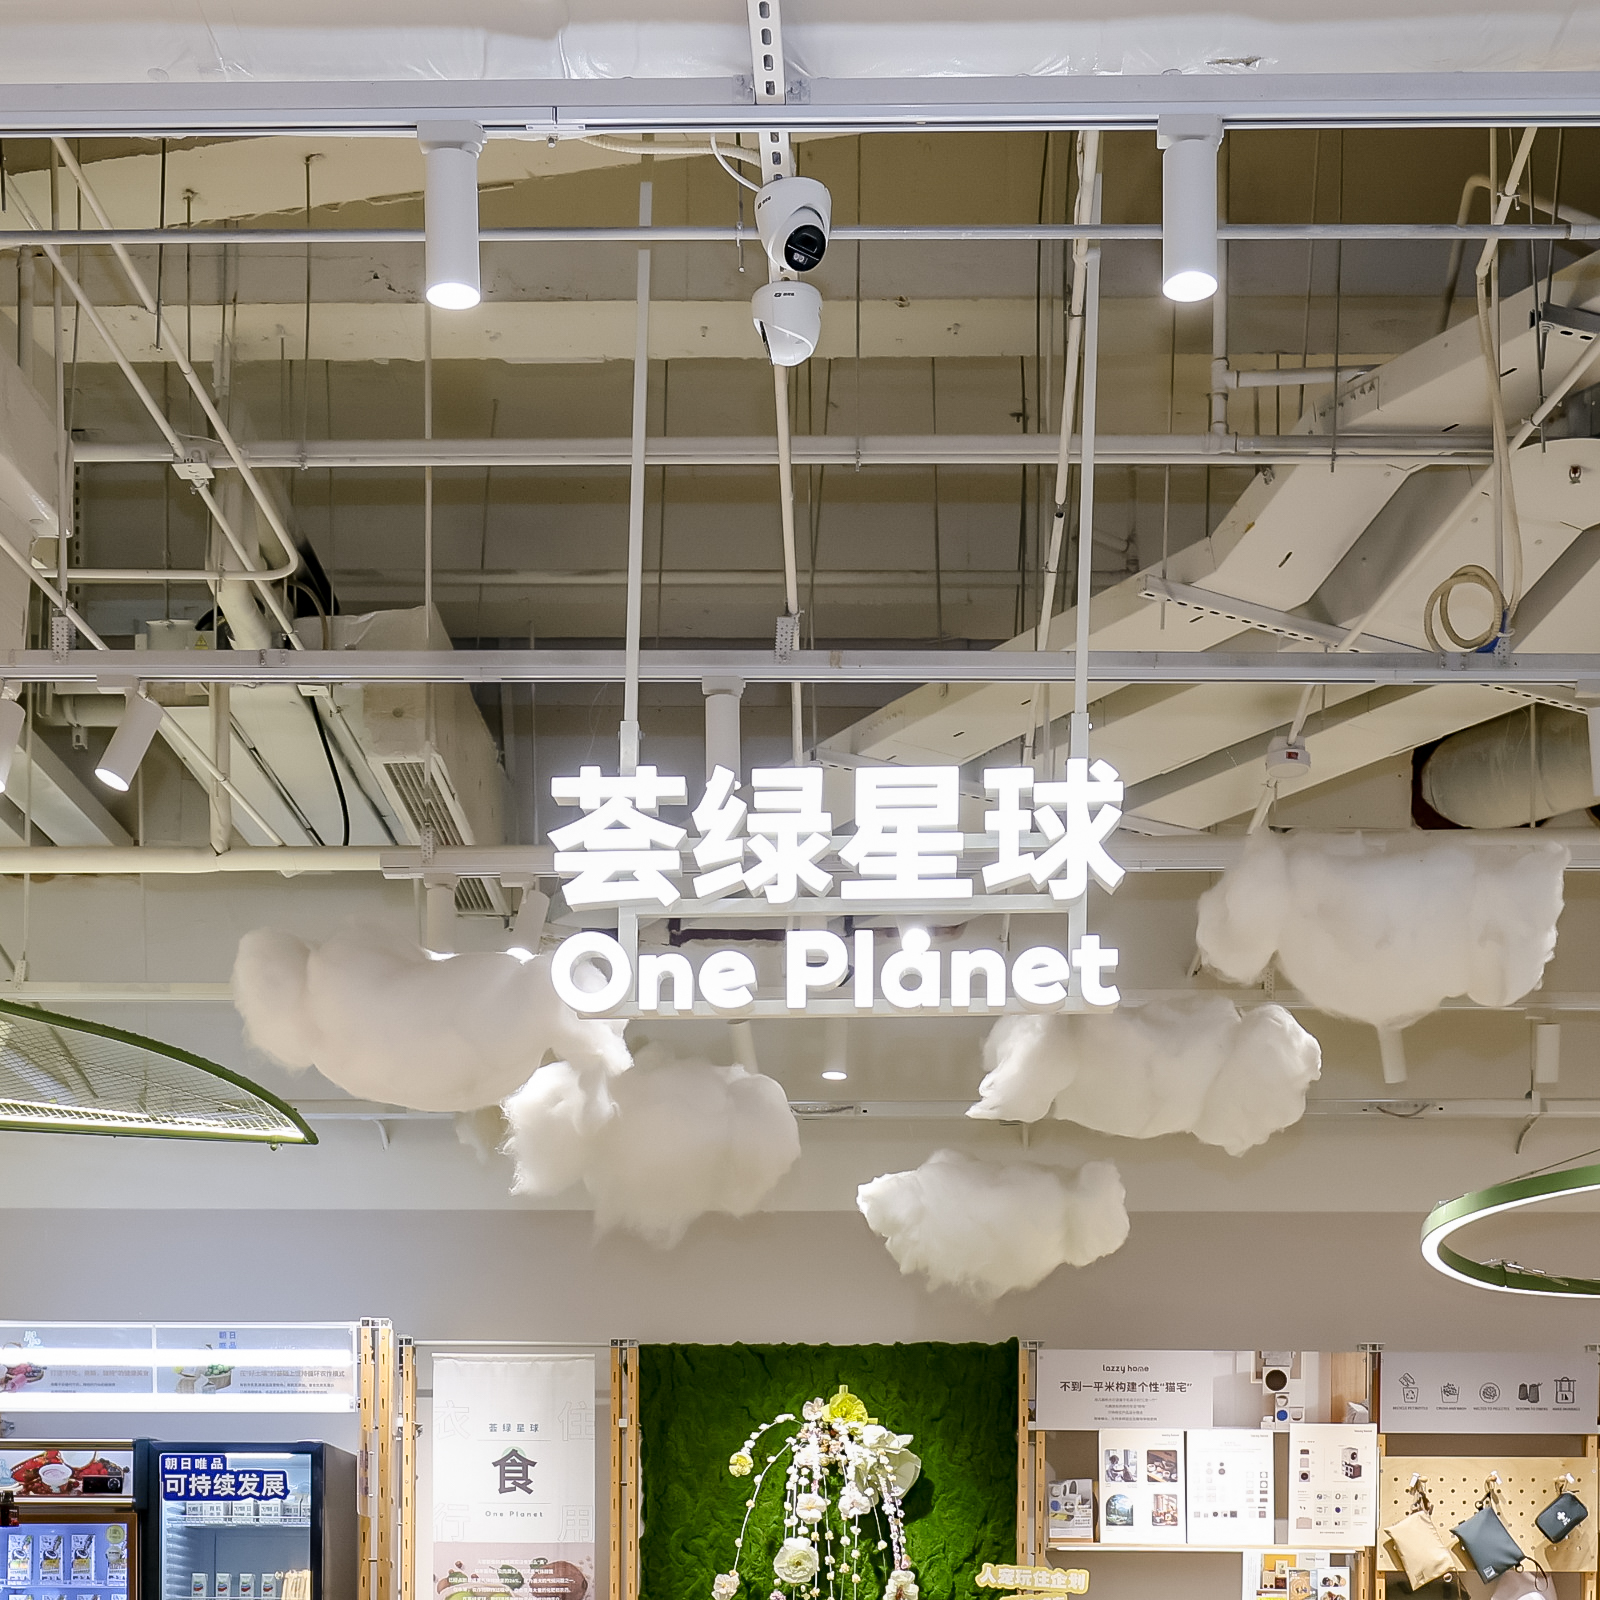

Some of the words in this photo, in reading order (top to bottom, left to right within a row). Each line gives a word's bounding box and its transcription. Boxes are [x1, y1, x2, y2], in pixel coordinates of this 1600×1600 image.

[547, 757, 1126, 911] 荟绿星球
[550, 929, 758, 1013] One
[786, 928, 1121, 1010] Planet
[1102, 1364, 1126, 1373] lazzy
[1127, 1364, 1149, 1372] home
[488, 1423, 539, 1433] 荟绿星球
[164, 1457, 224, 1470] 朝日唯品
[491, 1449, 538, 1495] 食
[164, 1473, 285, 1497] 可持续发展
[980, 1567, 1086, 1590] 人宠玩住企划
